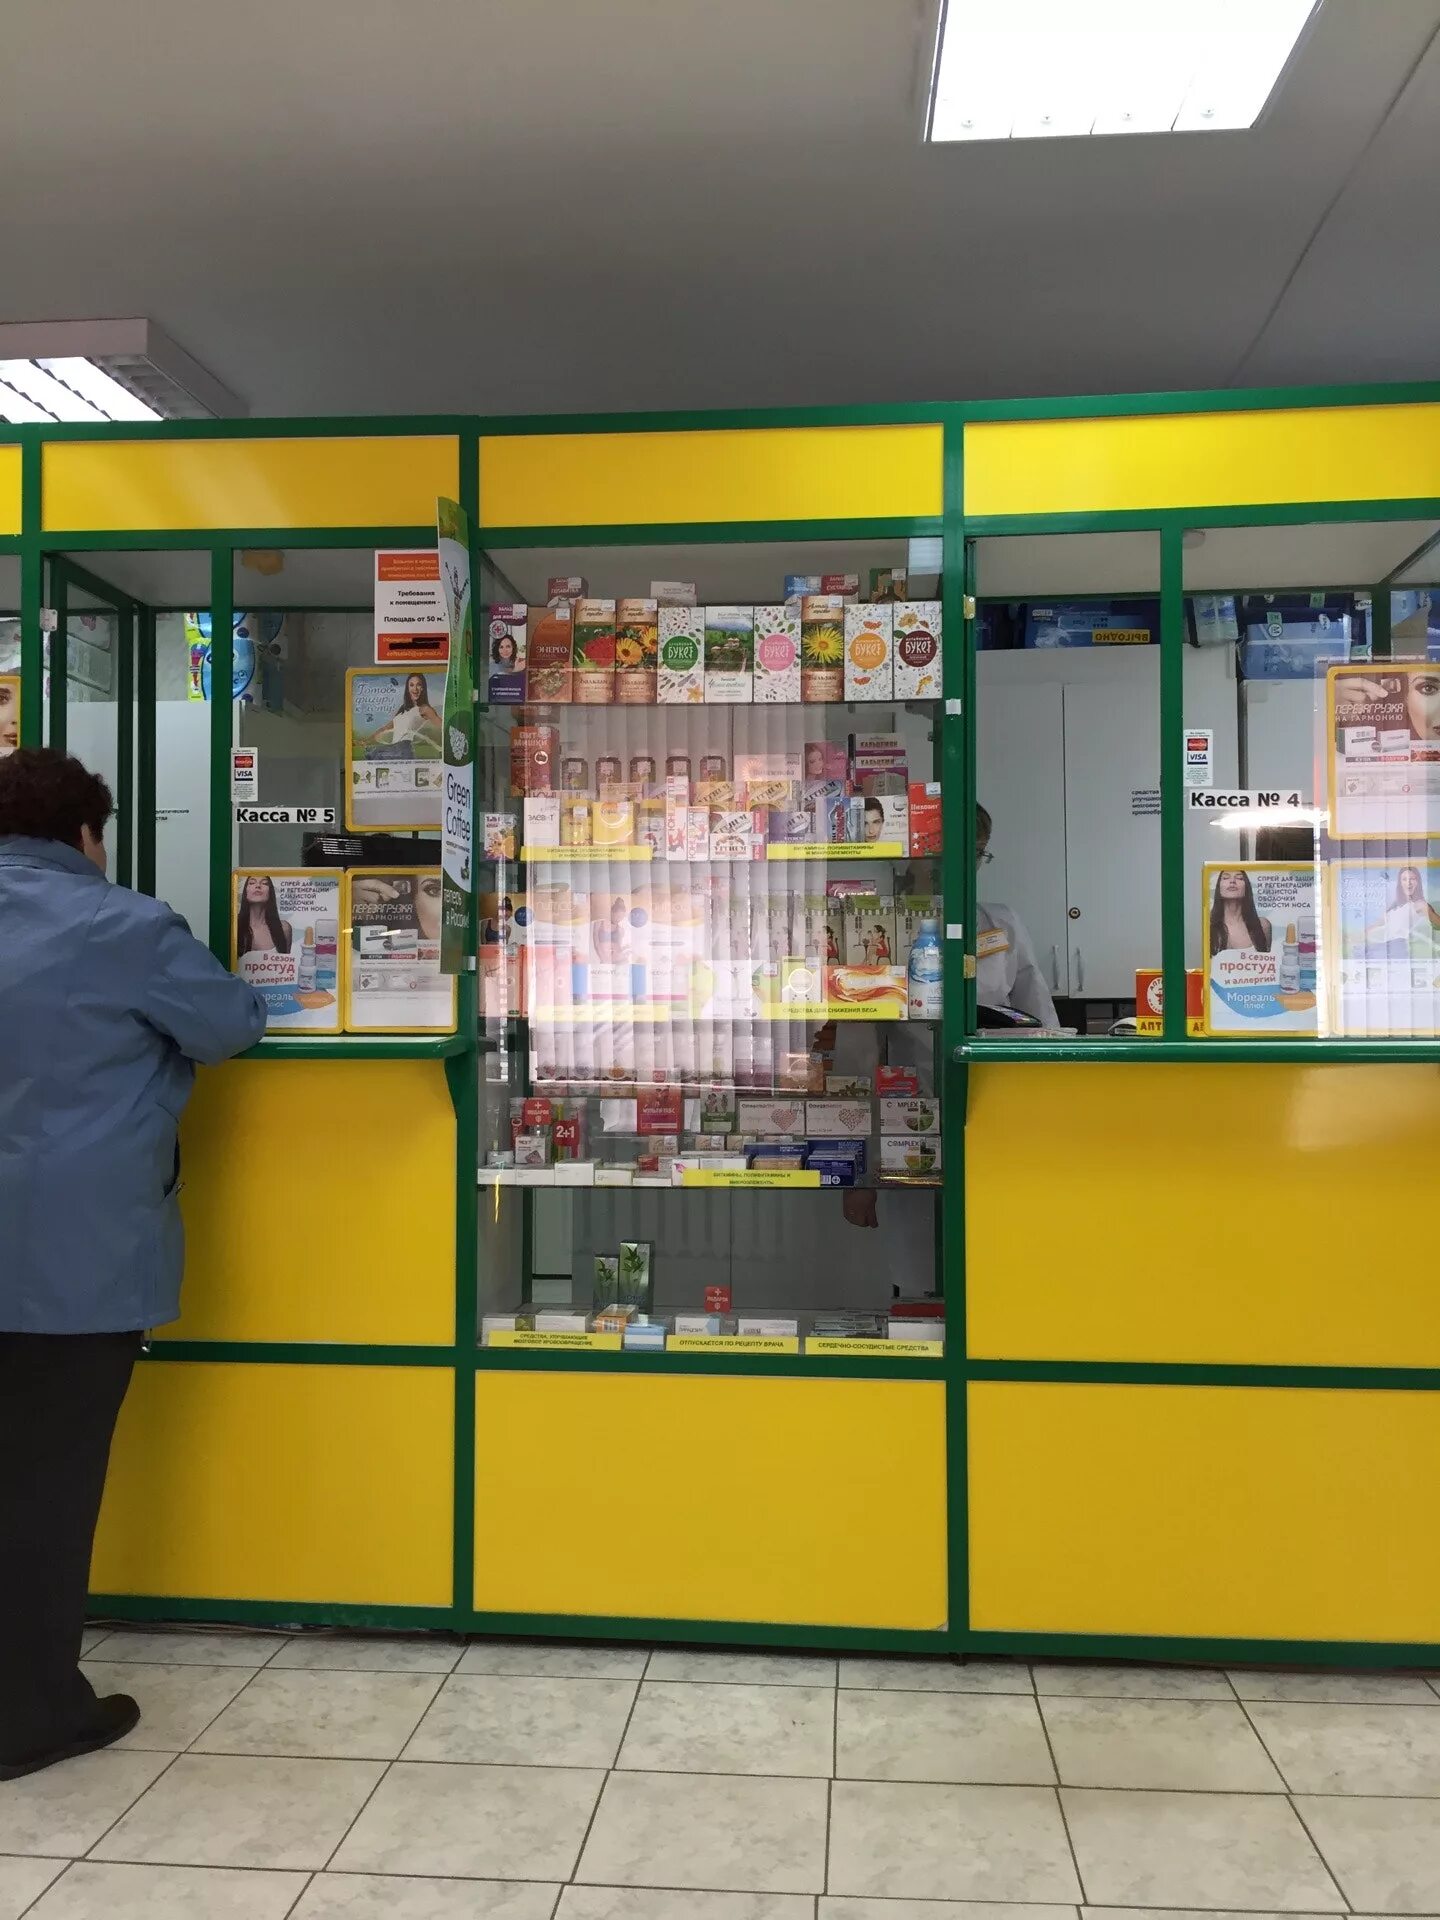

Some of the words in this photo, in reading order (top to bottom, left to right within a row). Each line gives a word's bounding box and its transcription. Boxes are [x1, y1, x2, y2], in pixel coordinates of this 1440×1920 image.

[905, 641, 932, 654] БУКЕТ
[1335, 703, 1404, 714] ПЕРЕЗАГРУЗКА
[446, 773, 471, 809] Green
[1191, 792, 1250, 807] Касса
[1257, 792, 1280, 807] №
[1287, 793, 1300, 807] 4
[236, 808, 290, 823] Касса
[296, 808, 317, 822] №
[323, 808, 335, 822] 5
[446, 806, 471, 842] Coffee
[352, 903, 413, 914] ПЕРЕЗАГРУЗКА
[263, 953, 269, 961] В
[270, 955, 295, 963] сезон
[1240, 952, 1246, 960] В
[1248, 953, 1276, 962] сезон
[245, 962, 296, 975] простуд
[1219, 962, 1276, 974] простуд
[255, 975, 295, 986] аллергий
[1232, 976, 1276, 986] аллергий
[262, 992, 294, 1003] реаль
[1227, 992, 1276, 1004] Мореаль
[1140, 1021, 1162, 1031] АПТ
[556, 1125, 575, 1139] 2+1
[818, 1342, 895, 1351] СЕРДЕЧНО-СОСУДИСТЫЕ
